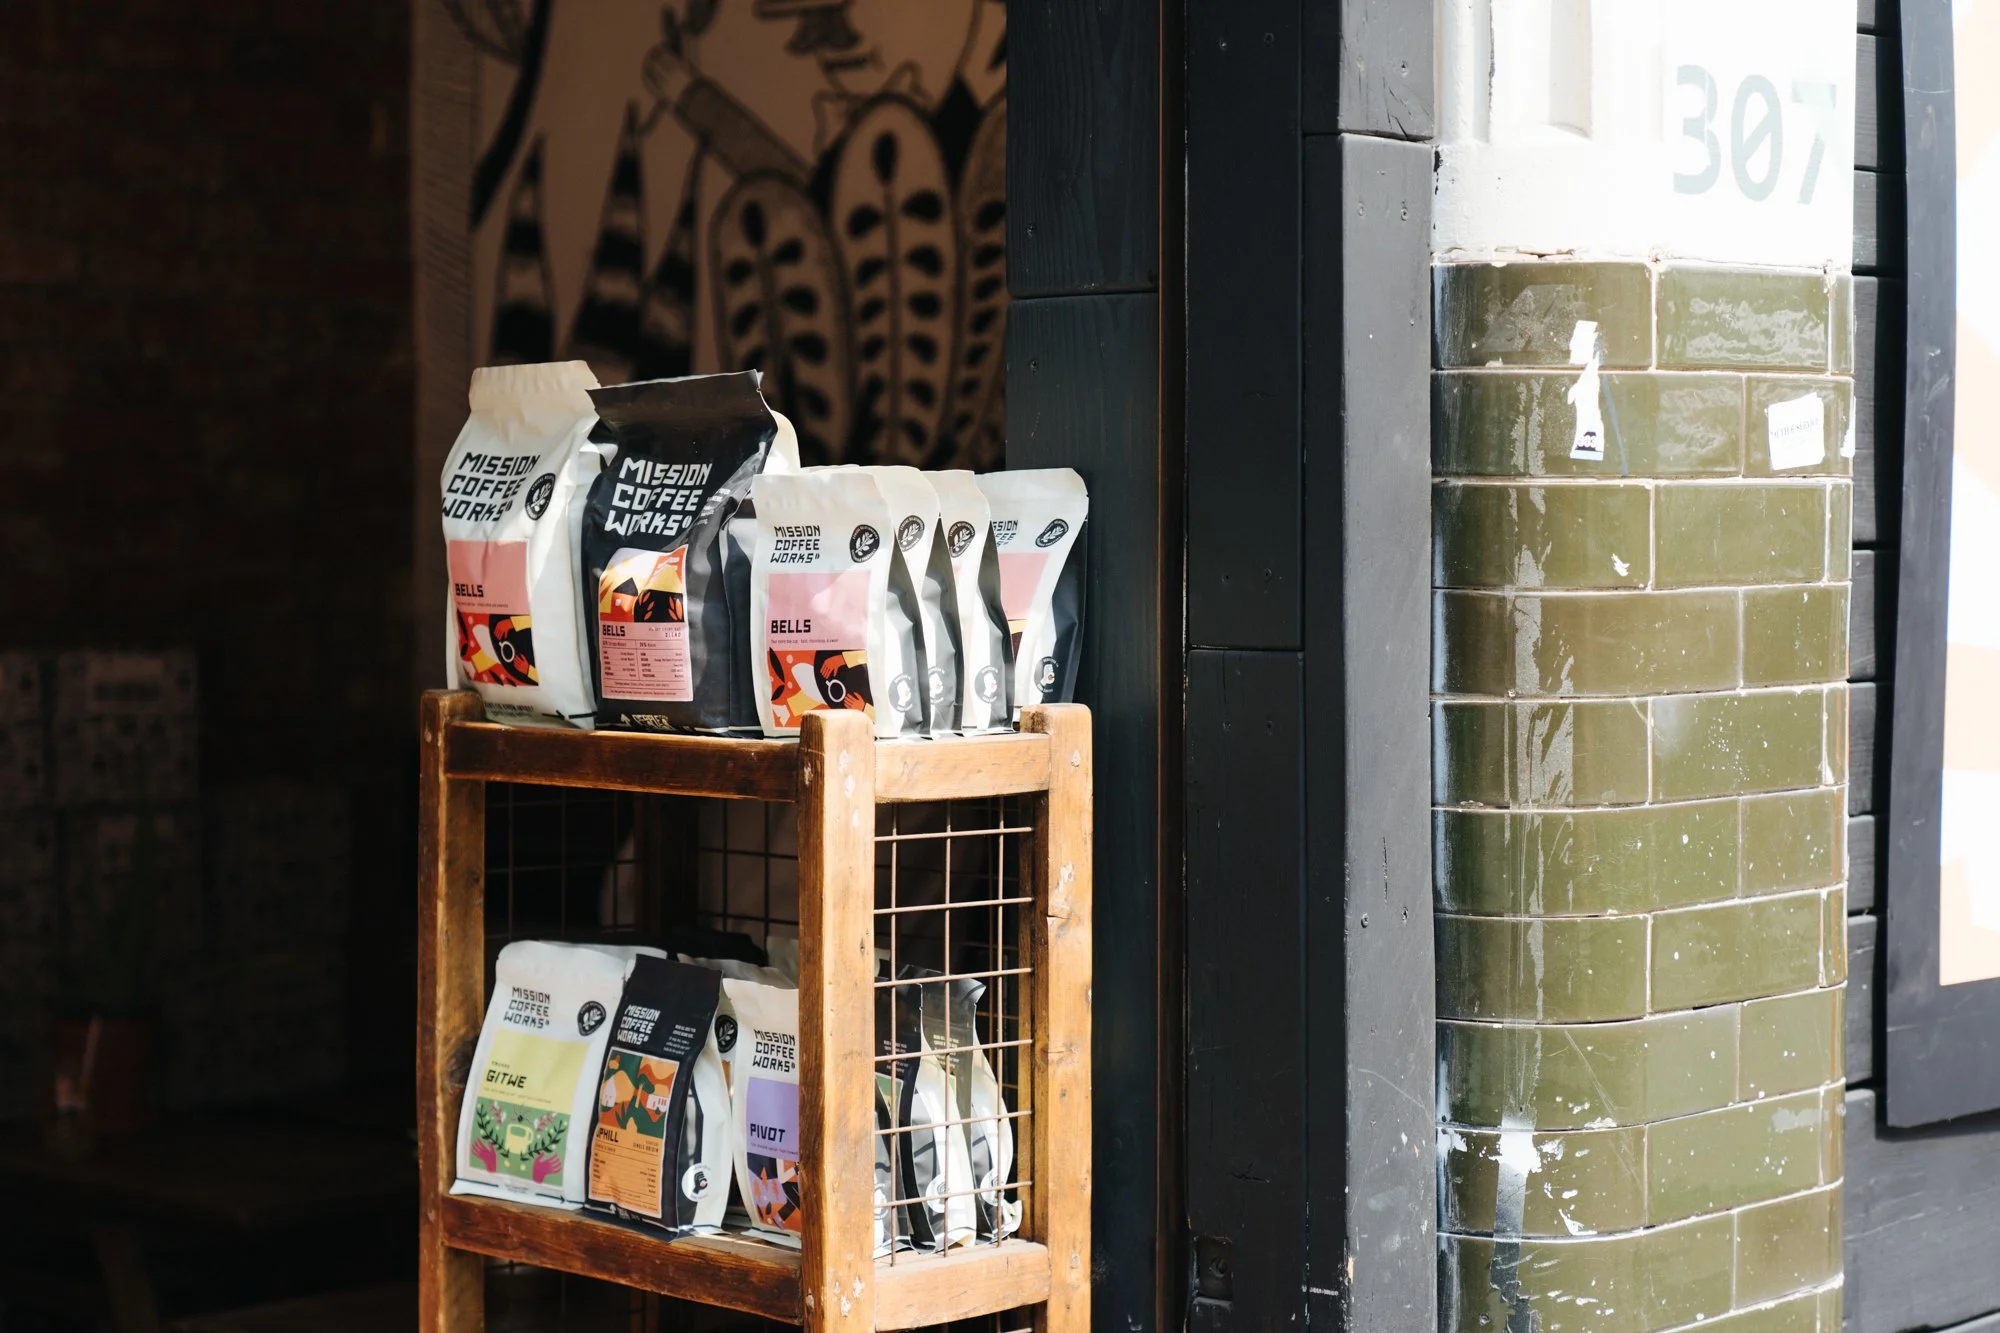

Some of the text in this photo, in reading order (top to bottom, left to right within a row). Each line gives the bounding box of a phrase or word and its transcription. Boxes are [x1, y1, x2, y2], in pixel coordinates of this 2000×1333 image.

[1673, 64, 1837, 205] 307
[458, 452, 541, 476] MISSION
[619, 457, 712, 486] MISSION
[446, 474, 526, 499] COFFEE
[611, 483, 703, 511] COFFEE
[442, 498, 507, 522] WORKS
[604, 510, 683, 536] WORKS
[773, 525, 820, 538] MISSION
[774, 539, 820, 551] COFFEE
[770, 552, 814, 563] WORKS
[455, 583, 484, 597] BELLS
[602, 624, 626, 637] BELLS
[771, 619, 811, 634] BELLS
[511, 986, 551, 1005] MISSION
[508, 999, 549, 1018] COFFEE
[624, 1004, 661, 1021] MISSION
[503, 1011, 544, 1029] WORKS
[620, 1016, 656, 1034] COFFEE
[617, 1029, 643, 1045] WORKS
[753, 1029, 796, 1046] MISSION
[755, 1041, 794, 1060] COFFEE
[752, 1055, 790, 1073] WORKS
[486, 1069, 527, 1088] GITWE
[750, 1123, 786, 1143] PIVOT
